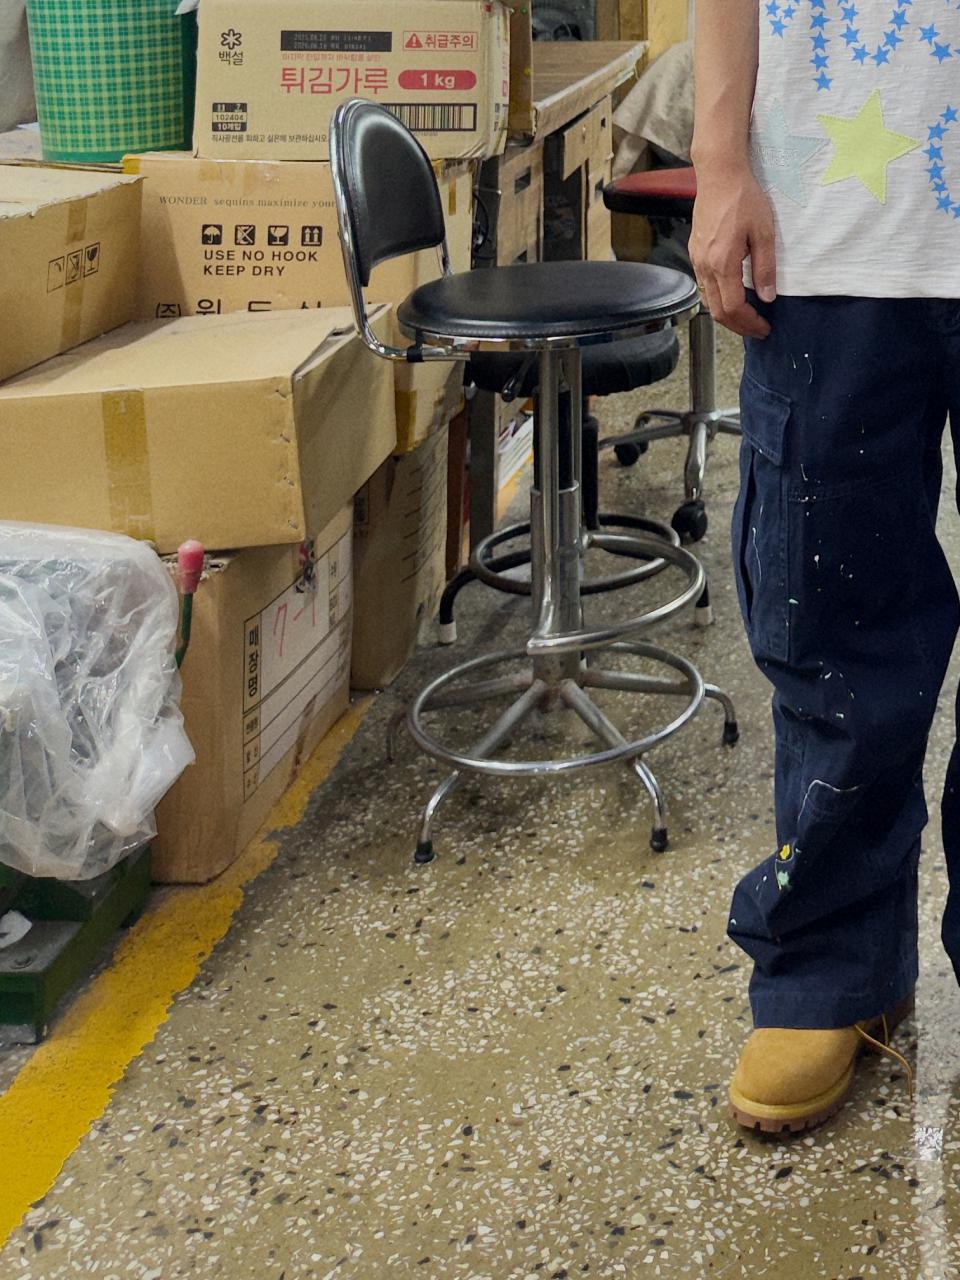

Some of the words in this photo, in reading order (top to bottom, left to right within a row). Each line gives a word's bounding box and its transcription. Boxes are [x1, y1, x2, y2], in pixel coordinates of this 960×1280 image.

[424, 34, 475, 49] 취급주의
[218, 50, 244, 66] 백설
[281, 67, 389, 94] 튀김가루
[420, 74, 428, 87] 1
[434, 73, 456, 88] kg
[159, 196, 208, 206] WONDER
[214, 198, 254, 208] sequins
[258, 198, 309, 208] maximize
[204, 250, 236, 261] USE
[243, 250, 265, 262] NO
[272, 250, 318, 262] HOOK
[203, 265, 245, 276] KEEP
[252, 266, 285, 277] DRY
